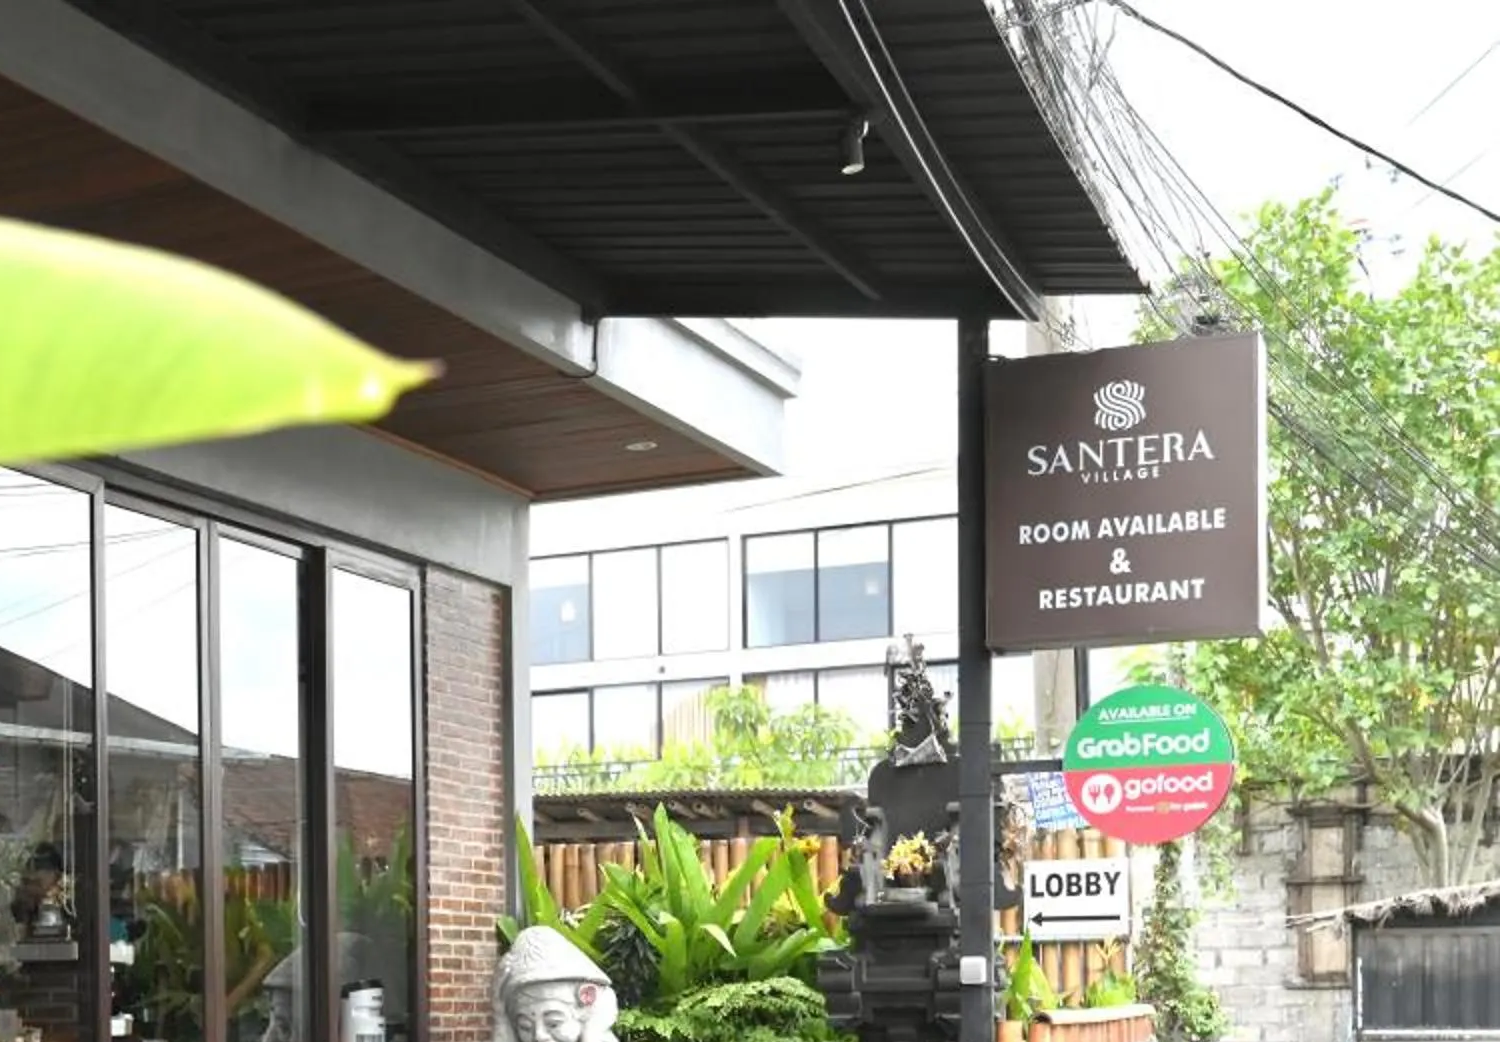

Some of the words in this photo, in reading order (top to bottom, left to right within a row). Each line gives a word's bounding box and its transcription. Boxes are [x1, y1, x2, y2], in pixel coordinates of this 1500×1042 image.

[1027, 429, 1215, 475] SANTERA
[1081, 465, 1161, 483] VILLAGE
[1018, 519, 1090, 545] ROOM
[1097, 507, 1227, 538] AVAILABLE
[1109, 547, 1131, 574] &
[1039, 578, 1205, 609] RESTAURANT
[1099, 705, 1171, 721] AVAILABLE
[1173, 703, 1197, 716] ON
[1077, 727, 1210, 759] GrabFood
[1124, 771, 1213, 800] gofood
[1030, 871, 1121, 897] LOBBY
